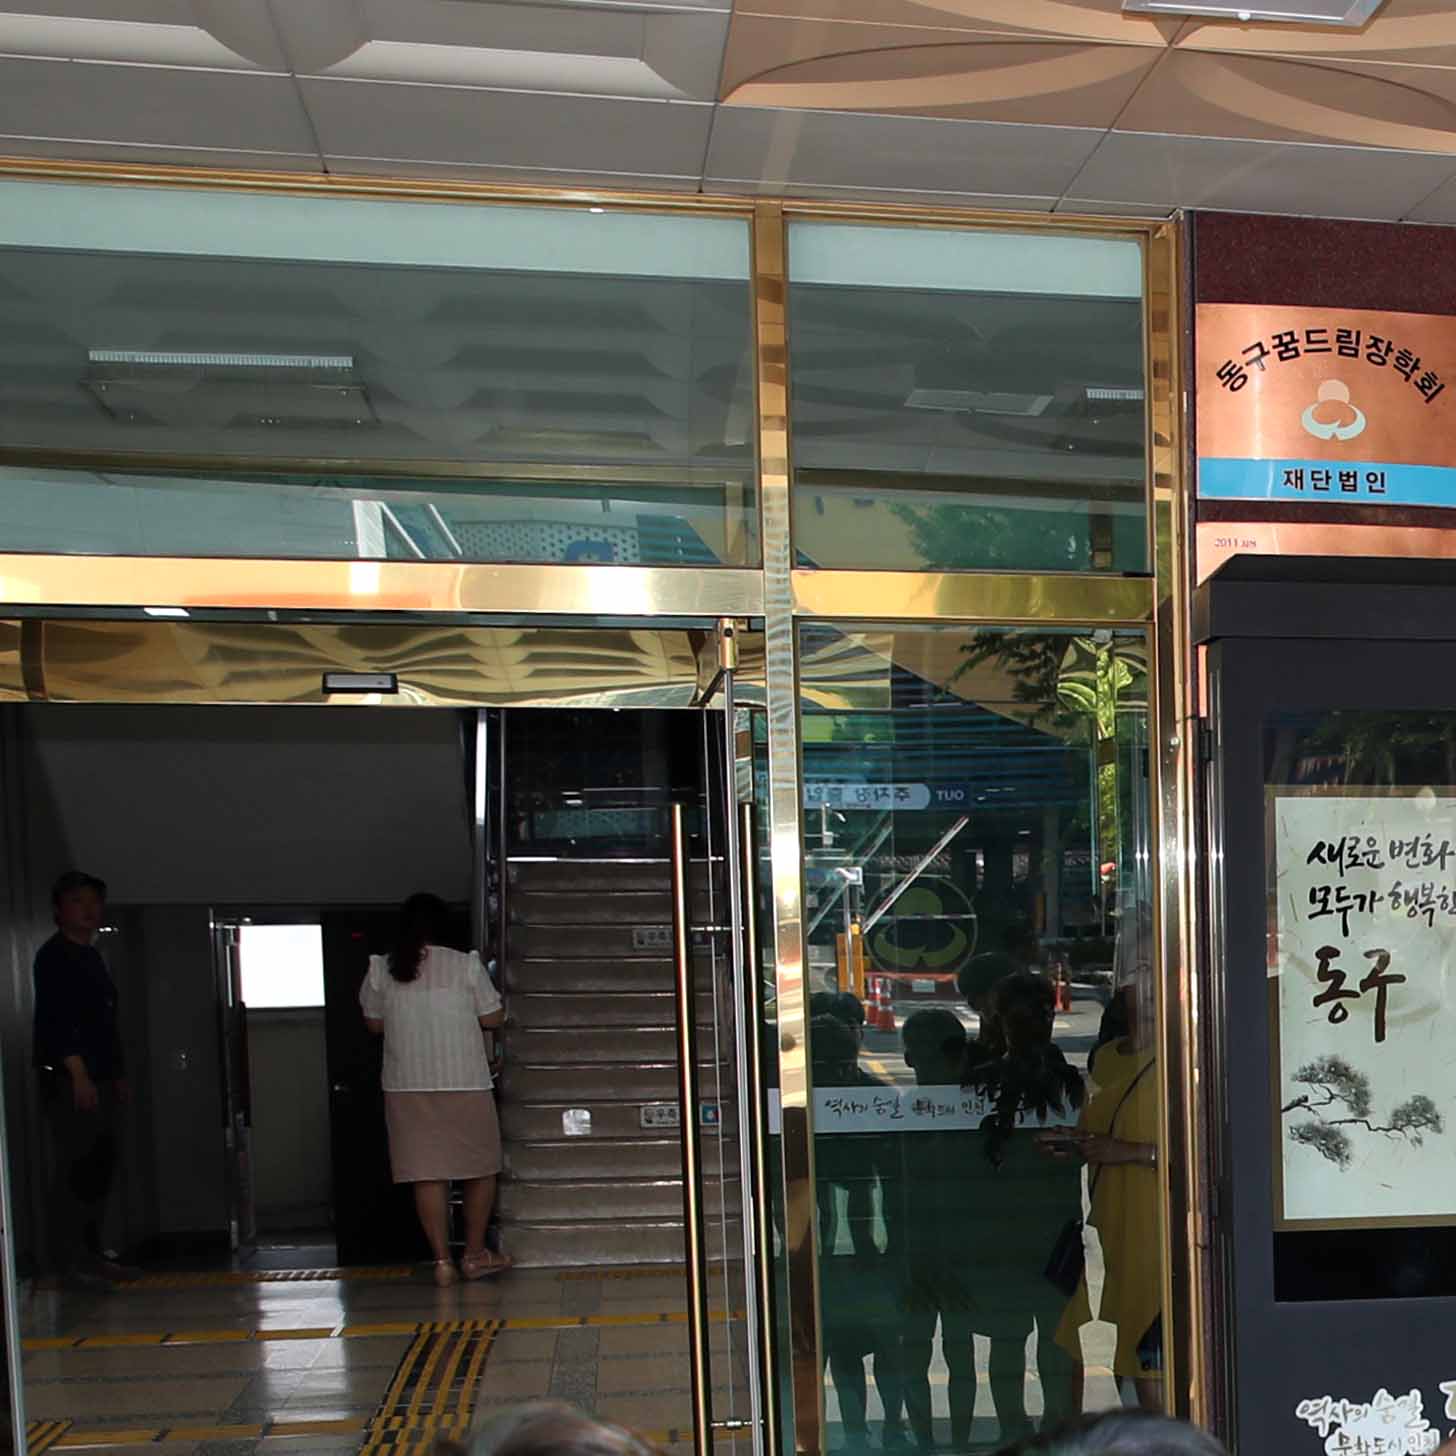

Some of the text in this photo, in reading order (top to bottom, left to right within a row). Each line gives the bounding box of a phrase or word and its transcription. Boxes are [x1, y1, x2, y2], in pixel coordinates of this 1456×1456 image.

[1216, 328, 1446, 404] 동구꿈드림장학회
[1283, 469, 1386, 494] 재단법인
[1306, 833, 1456, 877] 새로운 변화
[1307, 885, 1384, 937] 모두가
[1312, 945, 1407, 1043] 동구
